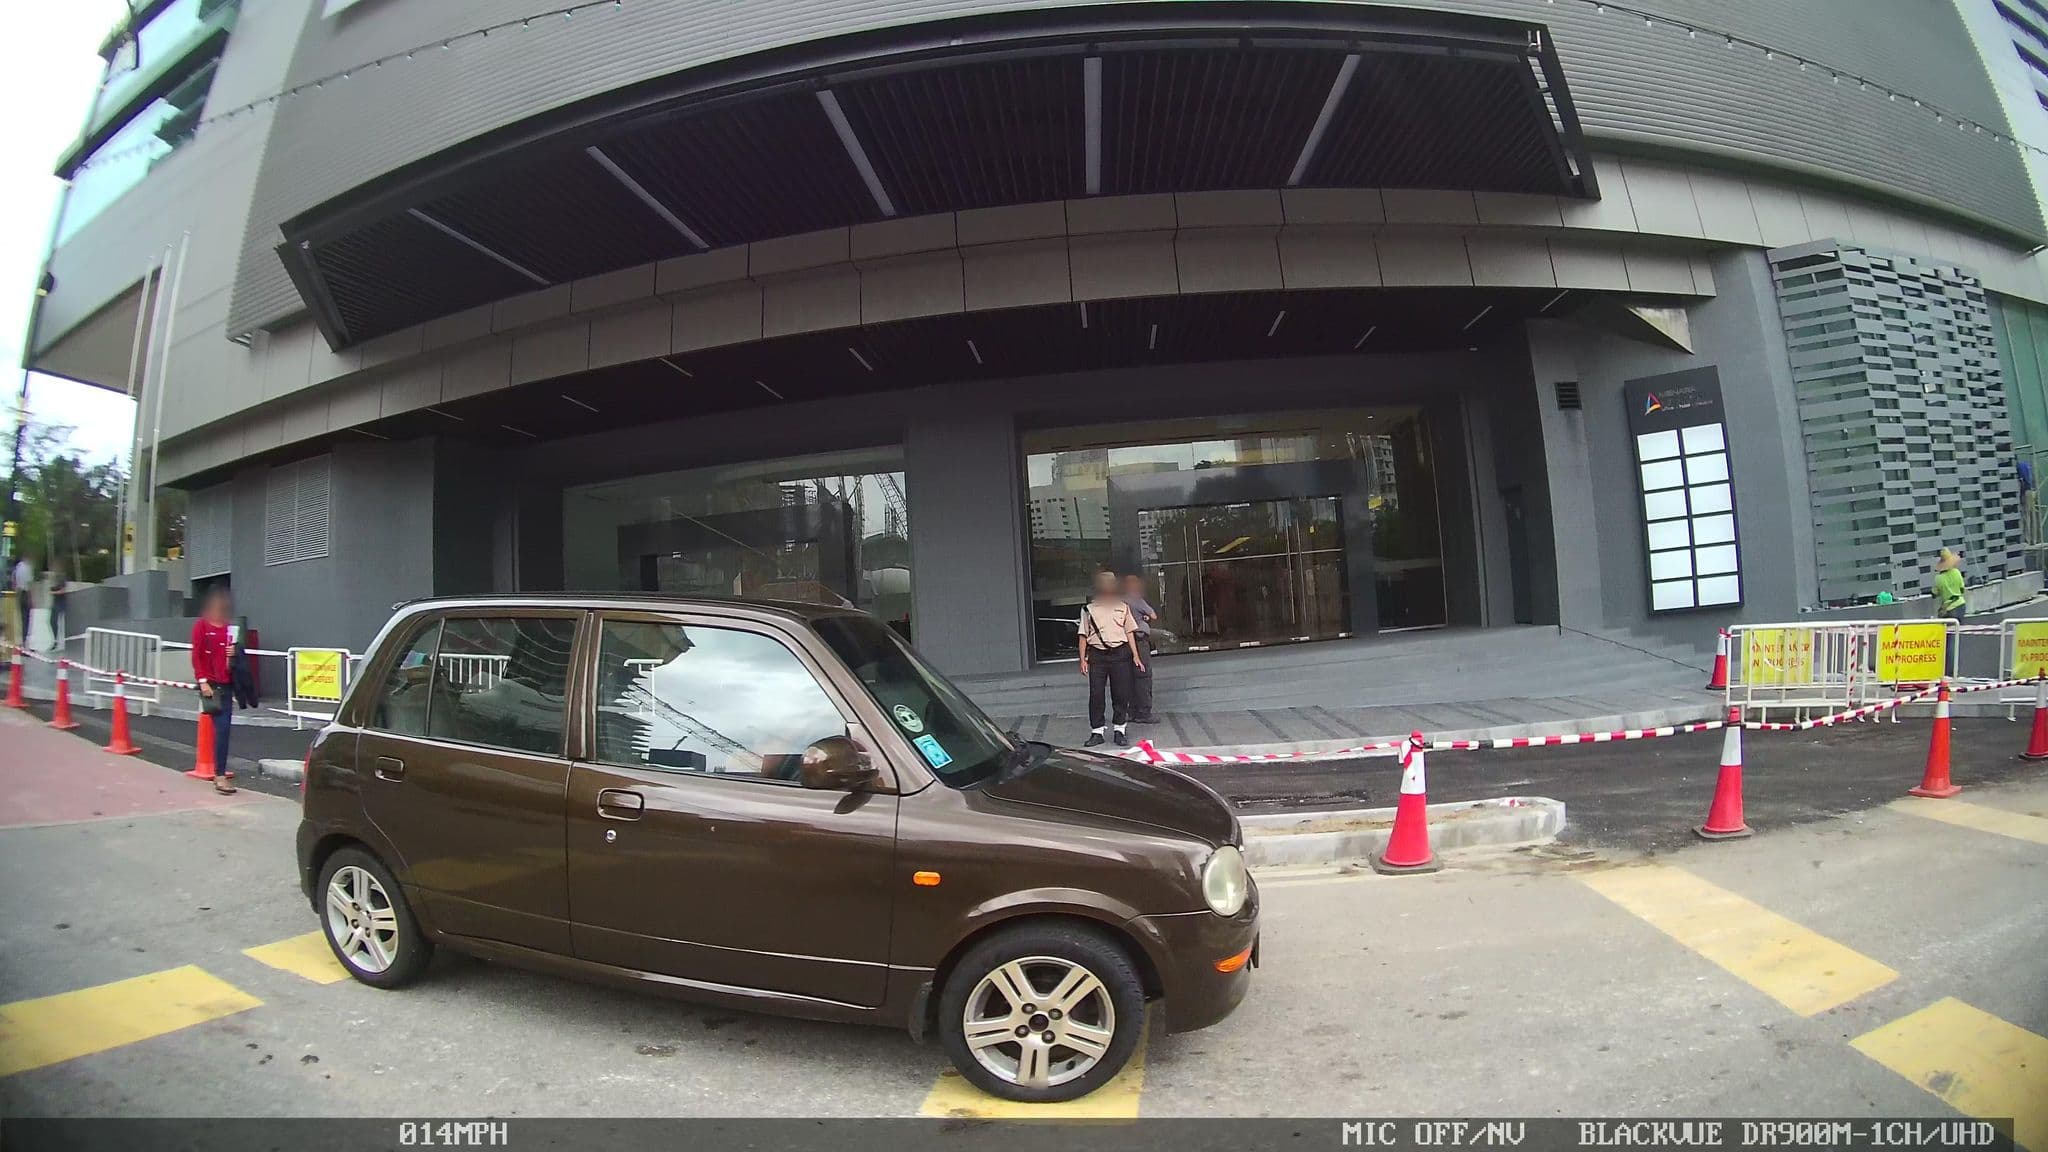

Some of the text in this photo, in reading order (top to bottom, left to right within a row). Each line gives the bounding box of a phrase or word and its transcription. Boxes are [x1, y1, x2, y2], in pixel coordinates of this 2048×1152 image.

[1882, 640, 1941, 651] MANTENANCE
[1886, 654, 1937, 664] IN PROGRESS
